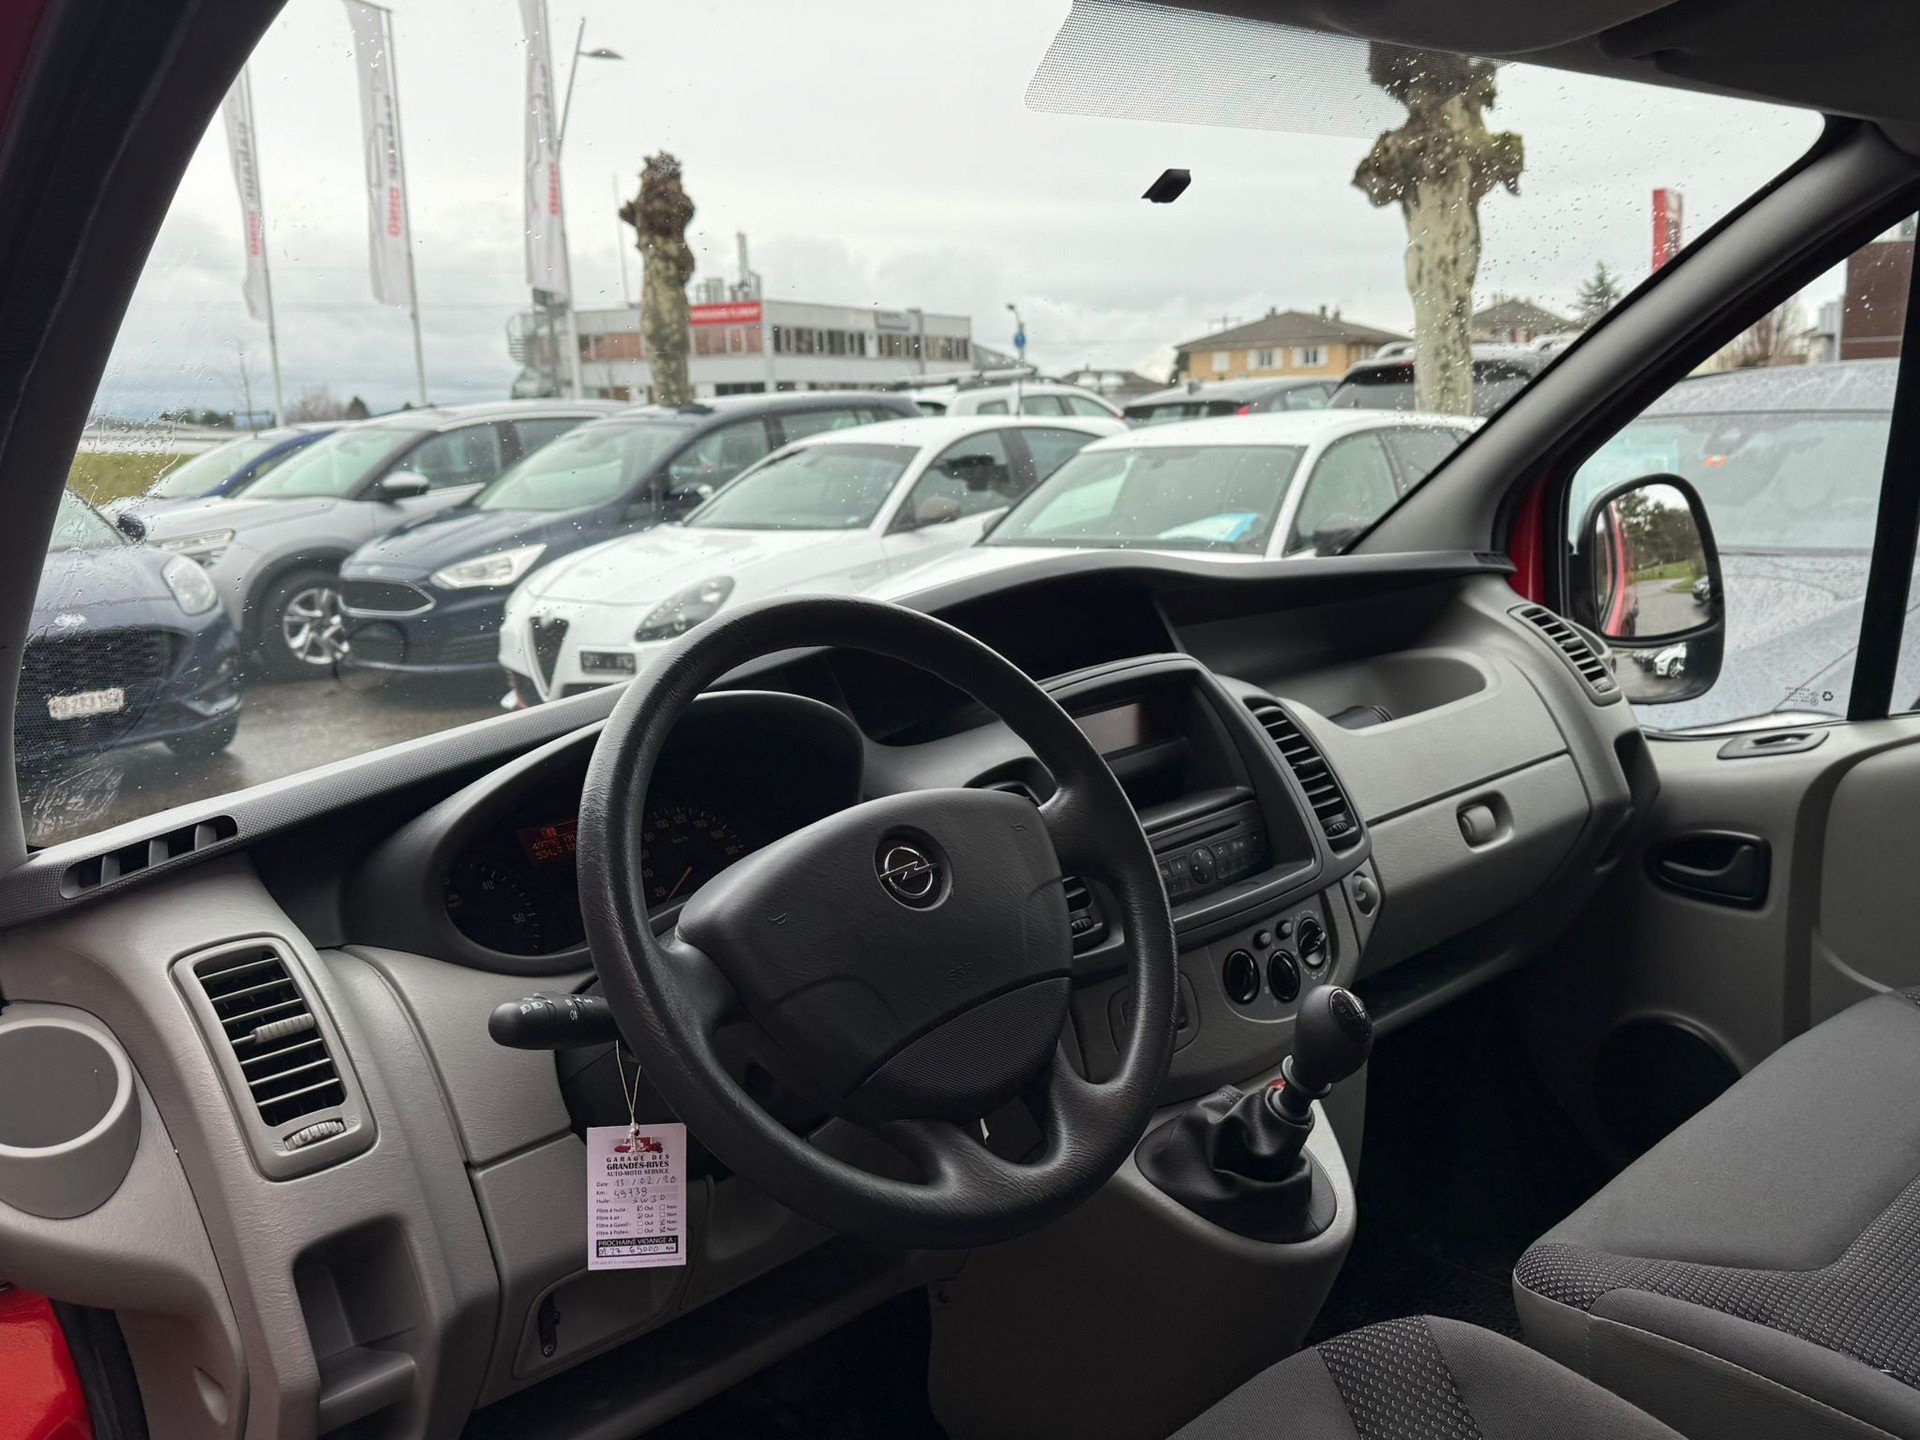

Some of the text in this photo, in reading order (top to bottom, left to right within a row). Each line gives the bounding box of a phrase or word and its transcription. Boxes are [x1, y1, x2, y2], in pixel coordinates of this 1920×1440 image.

[606, 1153, 670, 1163] GARAGE DES
[606, 1160, 670, 1171] GRANDES-RIVES
[644, 1168, 670, 1176] SERVICE
[598, 1239, 636, 1247] PROCHAINE
[637, 1237, 666, 1245] VIDANGE
